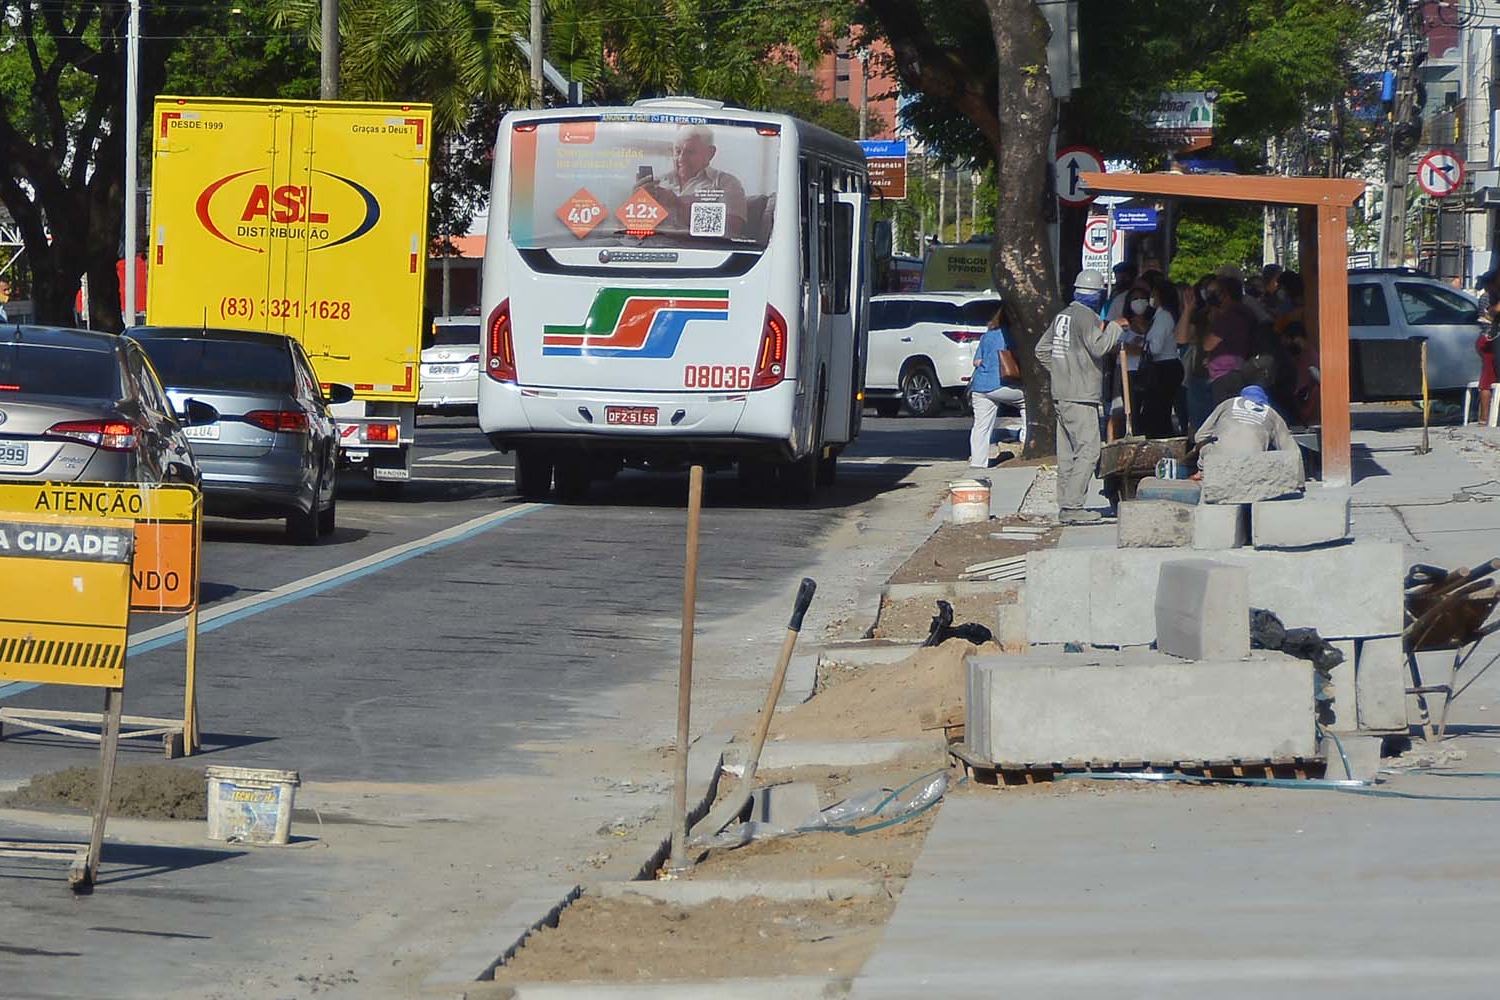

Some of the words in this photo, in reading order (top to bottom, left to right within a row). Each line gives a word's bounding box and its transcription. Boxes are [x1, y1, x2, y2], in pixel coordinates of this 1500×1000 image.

[171, 120, 202, 129] DESDE
[204, 121, 224, 130] 1999
[352, 124, 380, 134] Graças
[388, 125, 408, 134] Deus
[241, 184, 330, 224] ASL
[625, 203, 658, 219] 12x
[220, 297, 254, 321] (83)
[684, 365, 750, 389] 08036
[35, 489, 143, 517] ATENÇÃO
[16, 530, 120, 556] CIDADE
